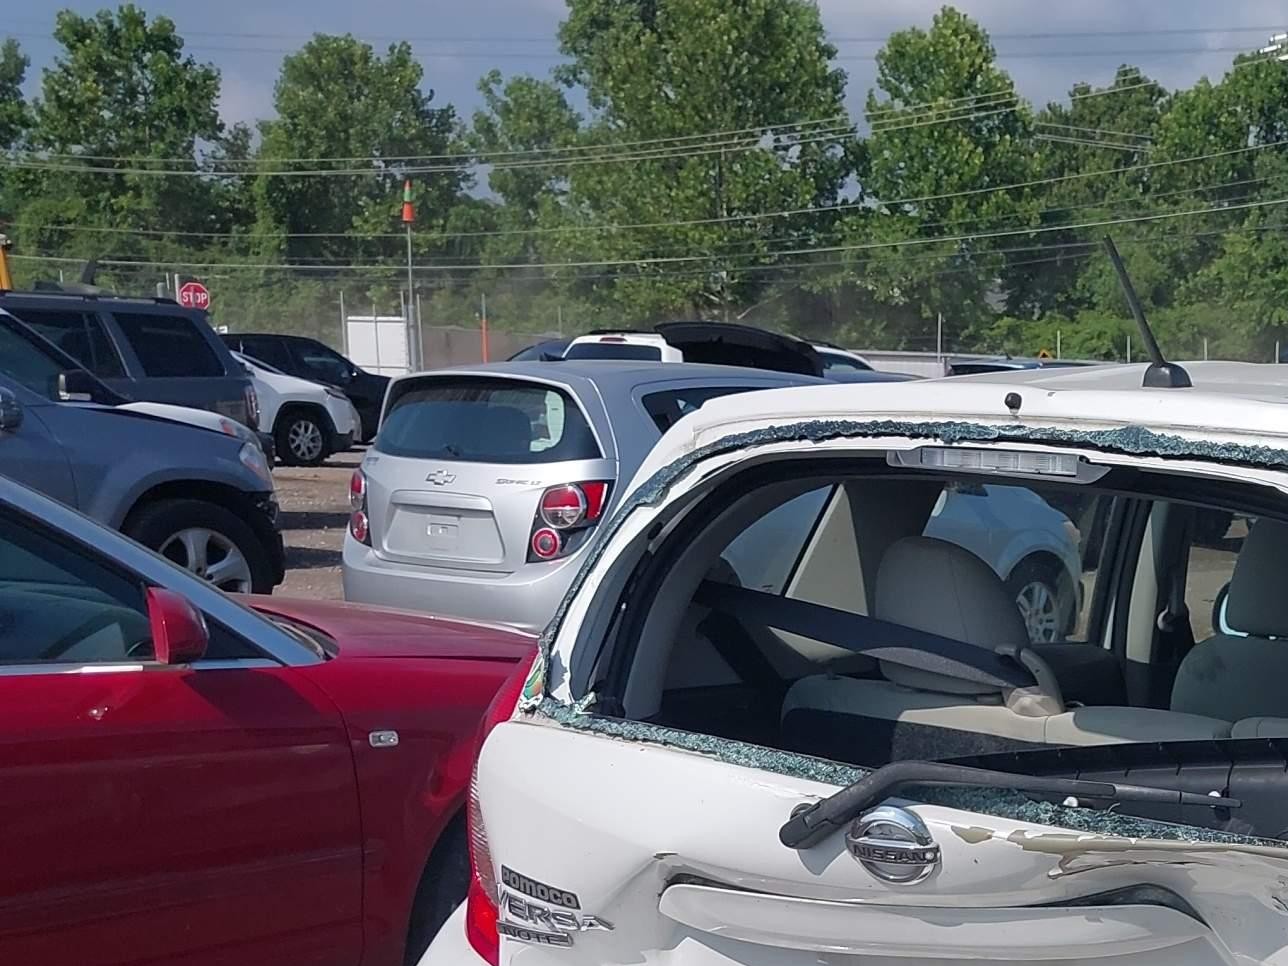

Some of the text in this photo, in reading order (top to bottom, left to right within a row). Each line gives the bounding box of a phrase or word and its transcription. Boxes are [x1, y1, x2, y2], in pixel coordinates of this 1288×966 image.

[183, 292, 207, 304] STOP
[852, 844, 928, 863] NISSAN
[500, 889, 616, 932] VERSA
[500, 924, 571, 947] NOTE
